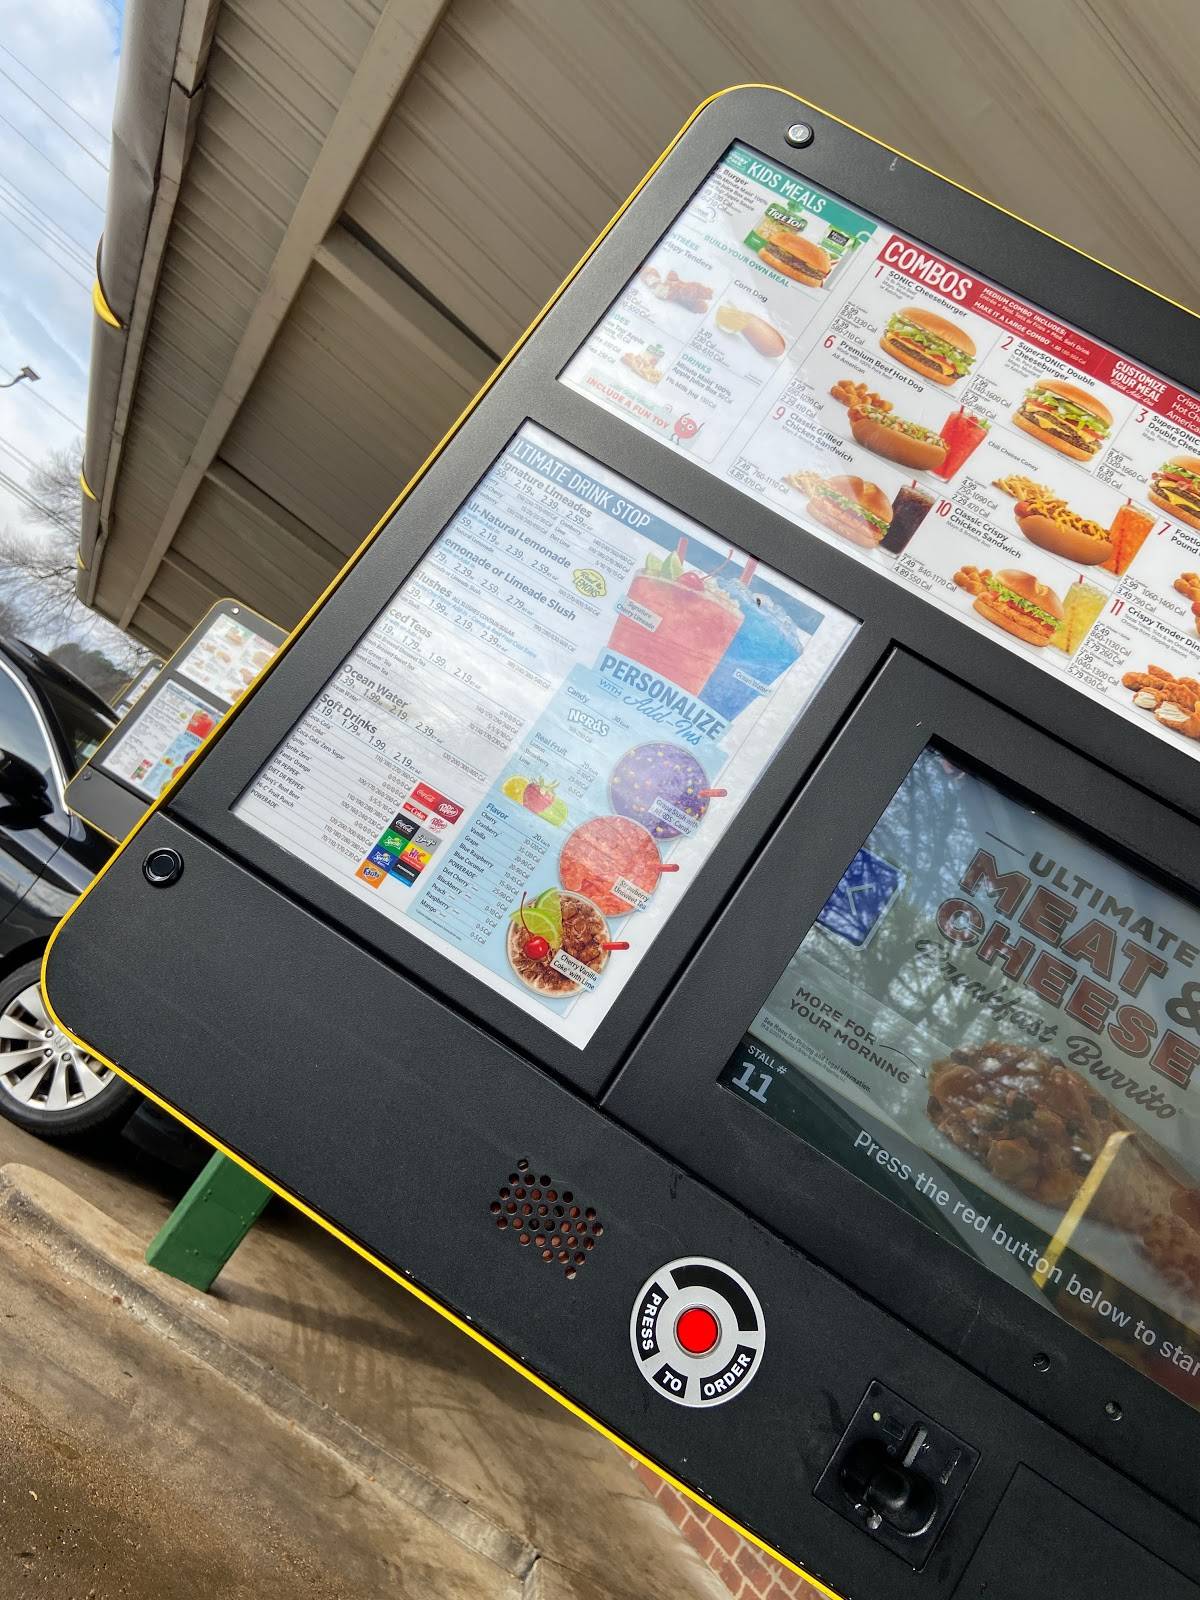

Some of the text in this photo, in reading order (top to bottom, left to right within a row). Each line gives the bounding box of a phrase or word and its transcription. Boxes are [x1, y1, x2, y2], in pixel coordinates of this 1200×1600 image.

[722, 169, 749, 188] Burger
[746, 161, 828, 213] KIDS MEALS
[702, 234, 791, 287] BUILD YOUR OWN MEAL
[872, 264, 885, 278] 1
[881, 239, 974, 301] COMBOS
[732, 279, 769, 303] Corn Dog
[887, 269, 968, 318] SONIC Cheeseburger
[973, 300, 993, 314] MAKE
[1003, 317, 1026, 333] LARGE
[1025, 328, 1050, 345] COMBO
[982, 287, 1067, 336] MEDIUM COMBO INCLUDES:
[821, 333, 838, 350] 6
[1000, 335, 1016, 351] 2
[681, 353, 712, 374] DRINKS
[838, 340, 924, 393] Premium Beef Hot Dog
[1012, 347, 1069, 382] Cheeseburger
[1016, 340, 1096, 387] SuperSONIC Double
[1108, 368, 1162, 402] YOUR MEAL
[1114, 360, 1167, 394] CUSTOMIZE
[585, 376, 669, 429] INCLUDE A FUN TOY
[771, 405, 787, 422] 9
[1170, 402, 1188, 415] Hot
[1133, 408, 1149, 424] 3
[788, 412, 843, 447] Classic Grilled
[1147, 421, 1178, 442] Double
[1151, 415, 1200, 446] SuperSONIC
[783, 419, 854, 463] Chicken Sandwich
[1019, 458, 1039, 473] Coney
[1107, 450, 1124, 463] 8.49
[497, 457, 545, 491] ignature
[543, 484, 593, 518] Limeades
[961, 478, 977, 491] 4.99
[566, 472, 615, 509] DRINK
[610, 498, 652, 531] STOP
[933, 498, 954, 518] 10
[951, 493, 968, 506] 2.29
[953, 506, 1009, 543] Classic Crispy
[1156, 521, 1171, 537] 7
[948, 513, 1022, 559] Chicken Sandwich
[1170, 535, 1199, 555] Pound
[517, 531, 572, 569] Lemonade
[892, 565, 909, 578] 4.89
[899, 556, 916, 568] 7.49
[440, 534, 493, 570] emonade
[490, 566, 504, 578] or
[503, 571, 549, 604] Limeade
[546, 598, 577, 621] Slush
[1122, 577, 1175, 611] 5.99 1060-1400
[1108, 598, 1125, 616] 11
[407, 617, 434, 638] Teas
[1093, 623, 1110, 636] 6.49
[1126, 605, 1155, 626] Crispy
[1153, 620, 1185, 642] Tender
[1077, 650, 1094, 663] 7.99
[1083, 639, 1101, 652] 3.79
[1066, 666, 1084, 679] 5.79
[341, 663, 409, 709] Ocean Water
[565, 685, 590, 704] Candy
[600, 680, 621, 697] WITH
[600, 654, 725, 740] PERSONALIZE
[319, 692, 378, 735] Soft Drinks
[292, 758, 311, 774] Orange
[330, 749, 346, 762] Sugar
[278, 761, 299, 777] PEPPER
[267, 787, 295, 808] Fruit Punch
[288, 790, 300, 800] Beer
[480, 811, 497, 824] Cherry
[486, 802, 509, 820] Flavor
[463, 834, 479, 847] Grape
[469, 827, 486, 840] Vanilla
[453, 850, 484, 873] Blue Coconut
[458, 842, 494, 868] Blue Raspberry
[436, 874, 463, 894] Blackberry
[442, 866, 469, 887] Diet Cherry
[425, 890, 450, 910] Raspberry
[431, 883, 447, 895] Peach
[617, 879, 649, 903] Strawberry
[419, 899, 437, 913] Mango
[1029, 850, 1200, 968] ULTIMATE
[959, 848, 1169, 998] MEAT
[559, 953, 598, 982] Cherry Vanilla
[567, 968, 582, 981] with
[580, 977, 596, 990] Lime
[936, 897, 1200, 1090] CHEESE
[796, 987, 878, 1046] MORE FOR
[915, 939, 1177, 1120] Breakfast Burrito
[789, 999, 910, 1084] YOUR MORNING
[747, 1045, 788, 1075] STALL #
[731, 1061, 773, 1104] 11
[853, 1129, 913, 1182] Press
[913, 1171, 950, 1206] the
[952, 1199, 992, 1234] red
[991, 1223, 1063, 1283] button
[1065, 1273, 1133, 1329] below
[1134, 1320, 1157, 1347] to
[641, 1292, 663, 1351] PRESS
[662, 1370, 682, 1391] TO
[704, 1353, 751, 1396] ORDER
